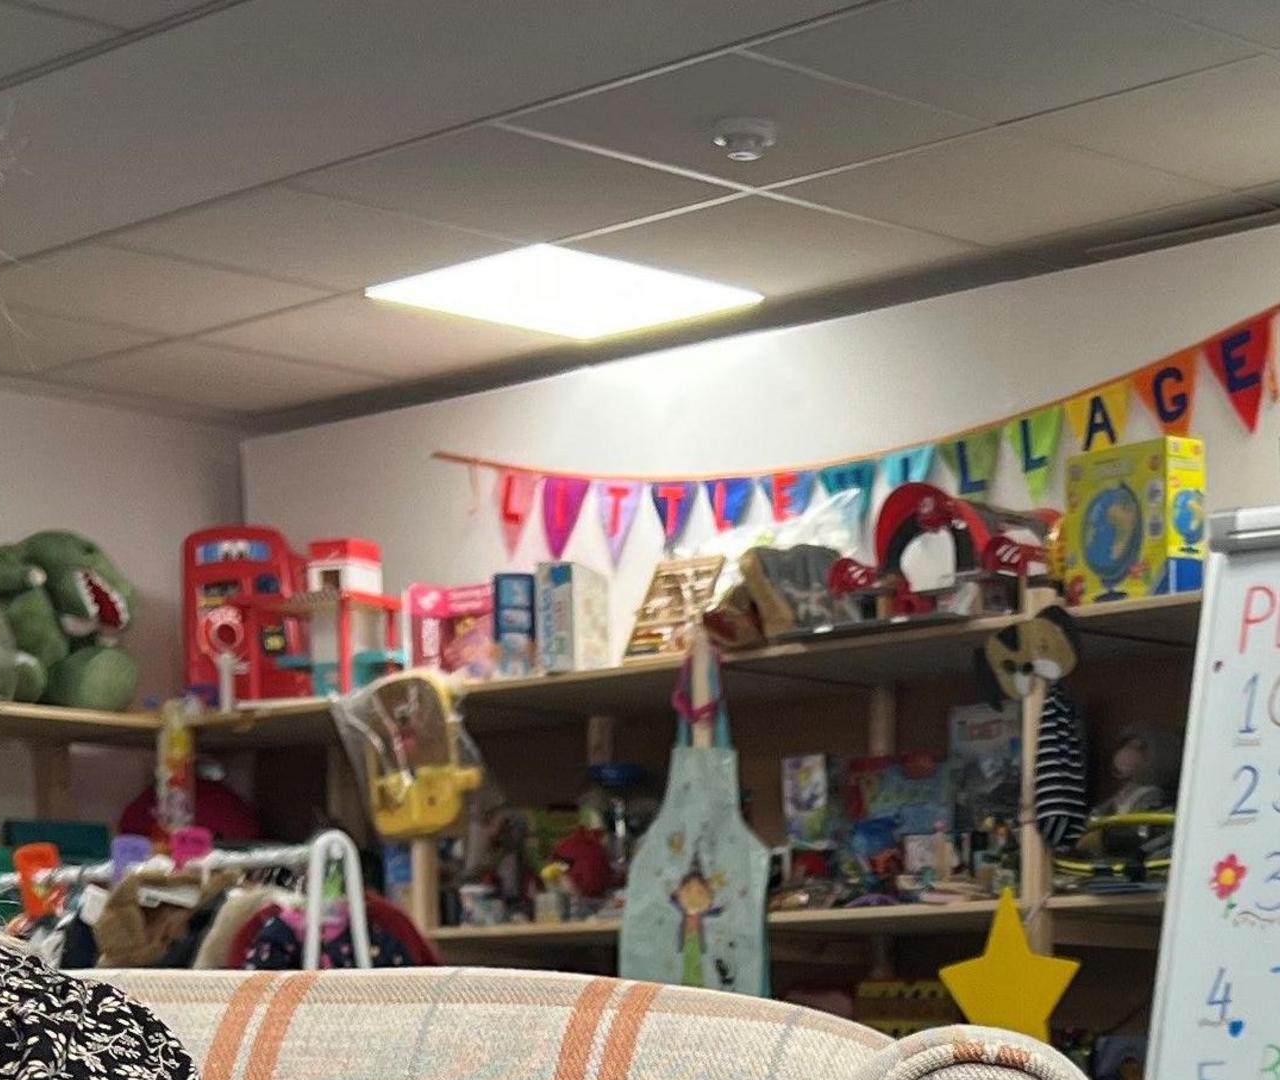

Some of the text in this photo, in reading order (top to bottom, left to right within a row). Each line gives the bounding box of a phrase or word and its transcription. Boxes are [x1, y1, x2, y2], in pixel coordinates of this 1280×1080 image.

[503, 471, 801, 533] LITTLE
[1238, 672, 1260, 734] 1
[1229, 764, 1259, 816] 2
[1206, 967, 1232, 1020] 4
